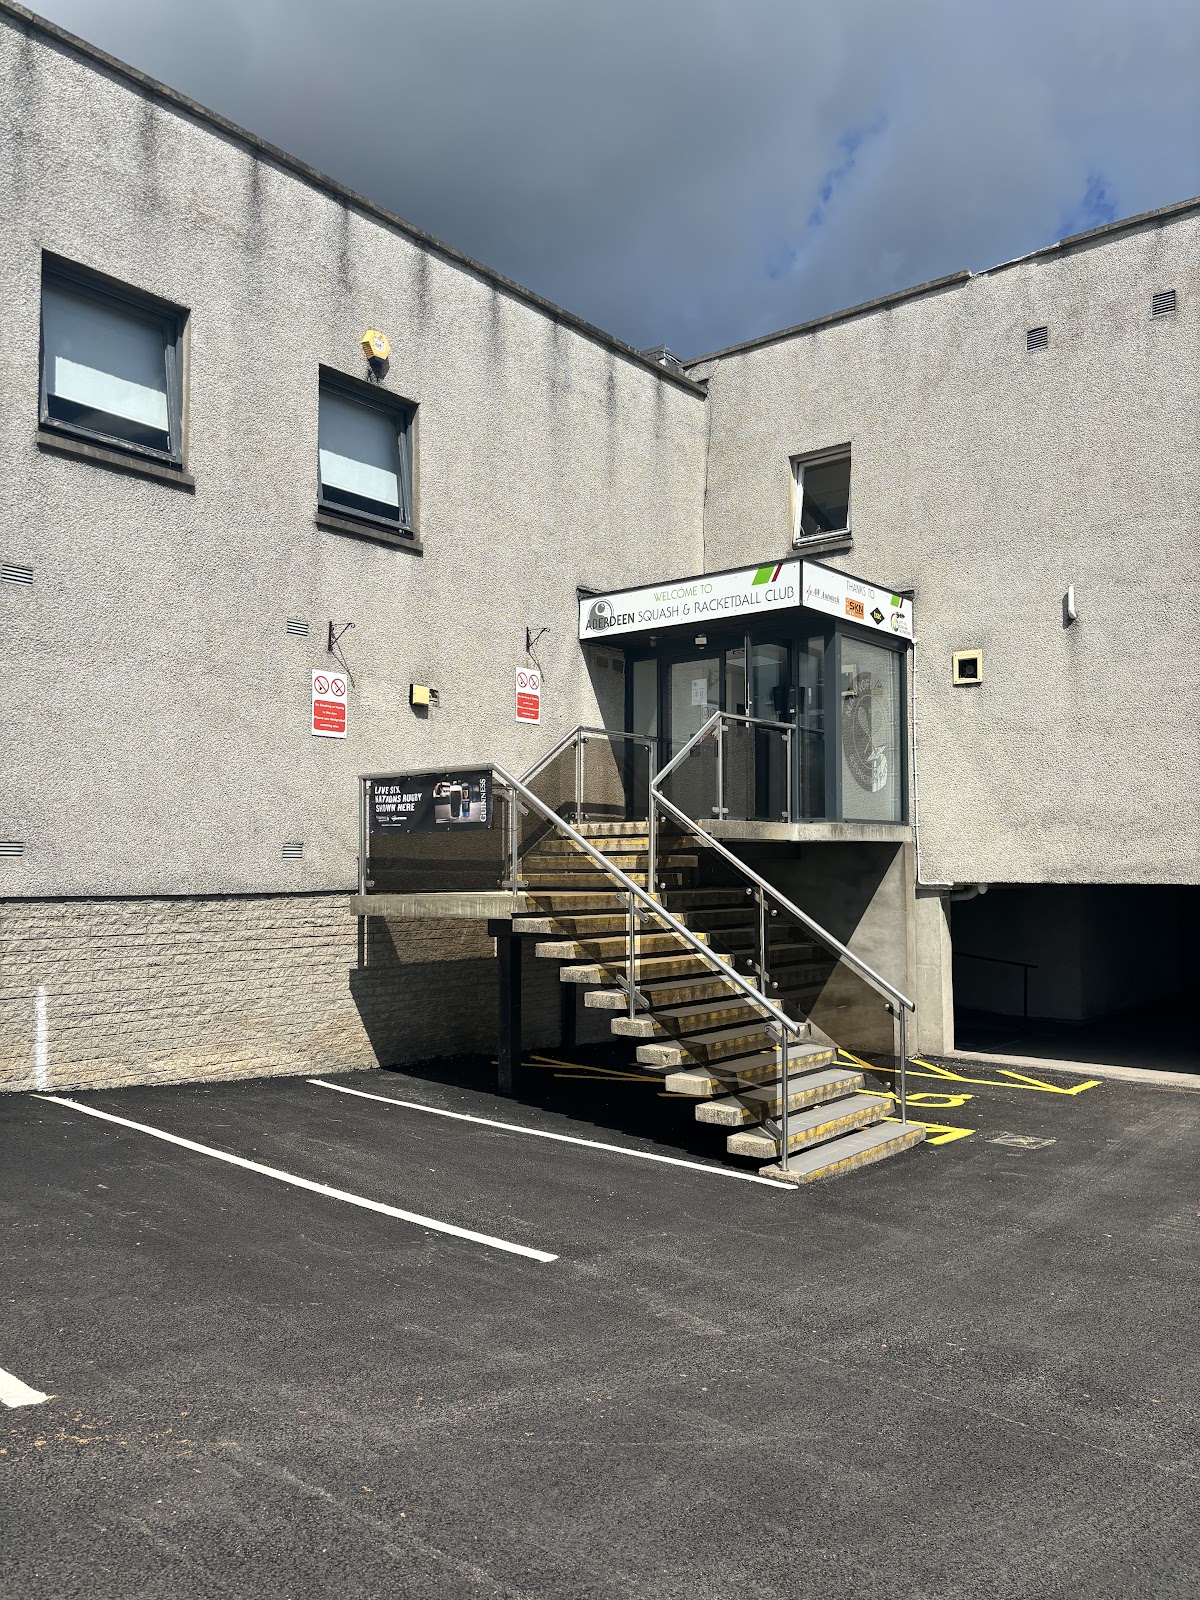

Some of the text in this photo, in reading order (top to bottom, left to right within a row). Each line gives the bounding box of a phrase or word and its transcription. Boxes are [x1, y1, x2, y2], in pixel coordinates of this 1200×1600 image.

[654, 583, 713, 602] WELCOME TO
[846, 580, 875, 600] THANKS TO
[585, 586, 795, 631] ABERDEEN SQUASH & RACKETBALL CLUB
[849, 602, 864, 614] SKN
[374, 785, 401, 795] LIVE SIX
[375, 793, 422, 803] NATIONS RUGBY
[376, 802, 415, 813] SHOWN HERE
